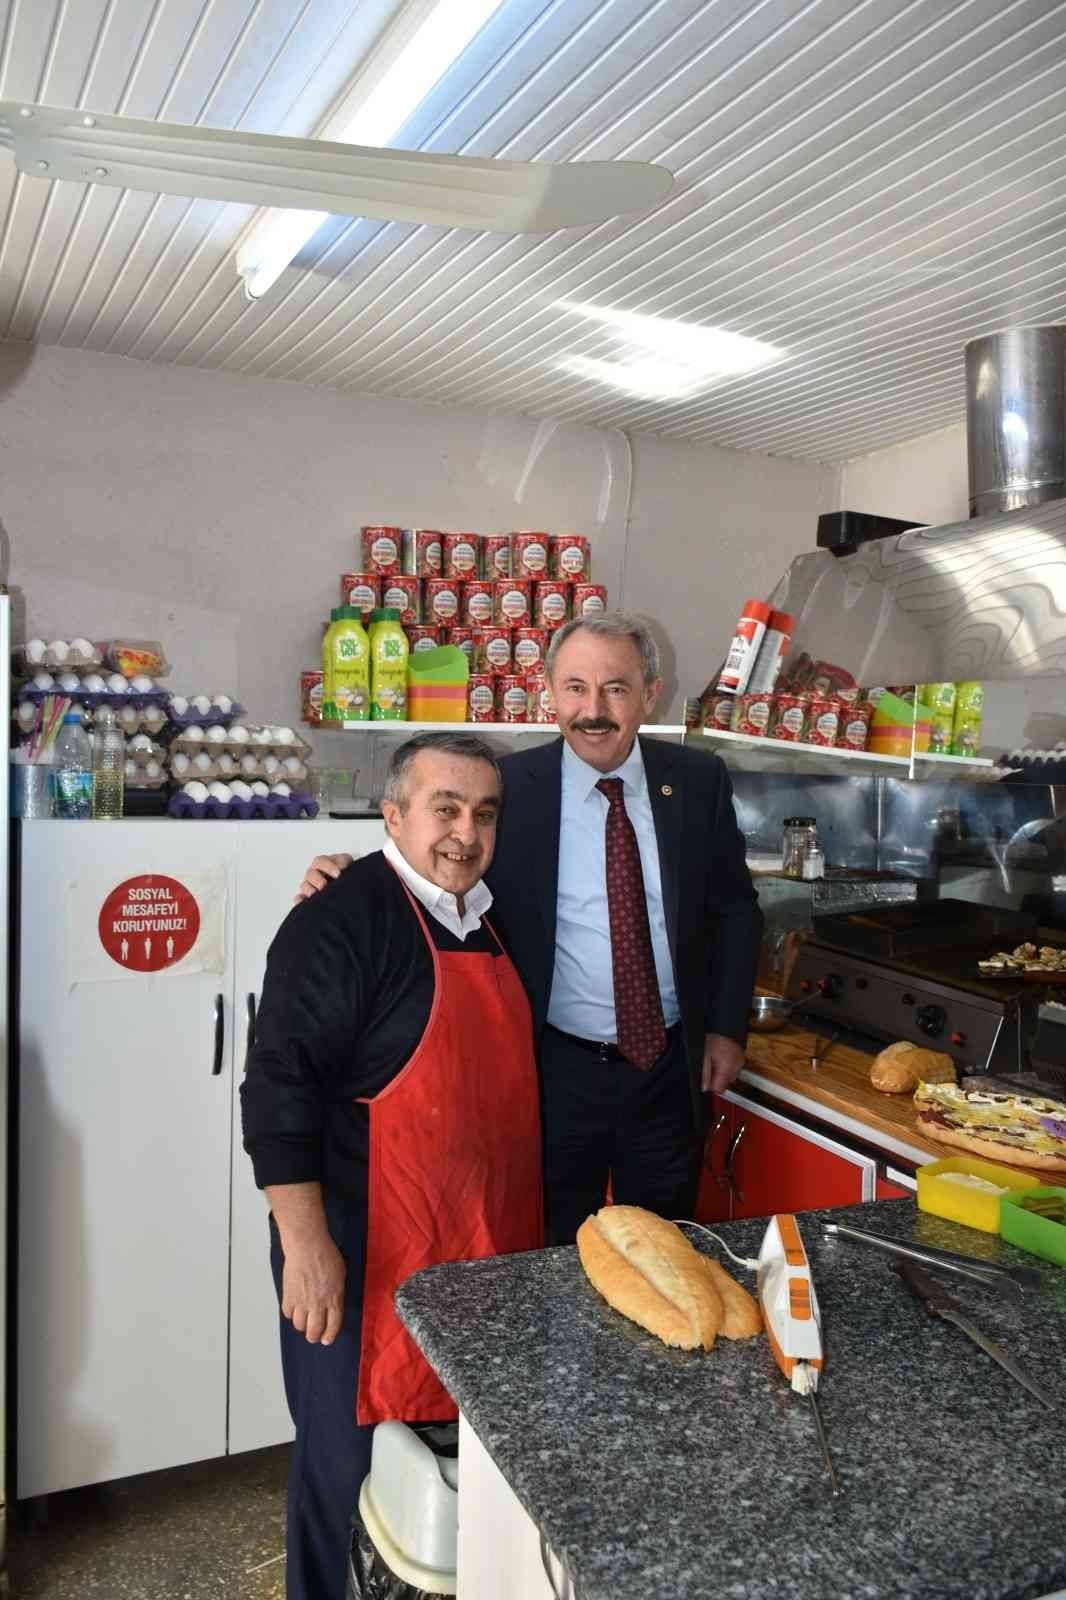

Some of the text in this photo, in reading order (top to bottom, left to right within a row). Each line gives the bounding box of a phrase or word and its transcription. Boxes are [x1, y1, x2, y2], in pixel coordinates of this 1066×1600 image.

[128, 888, 173, 900] SOSYAL
[122, 901, 178, 916] MESAFEYİ
[112, 919, 187, 932] KORUYUNUZ!
